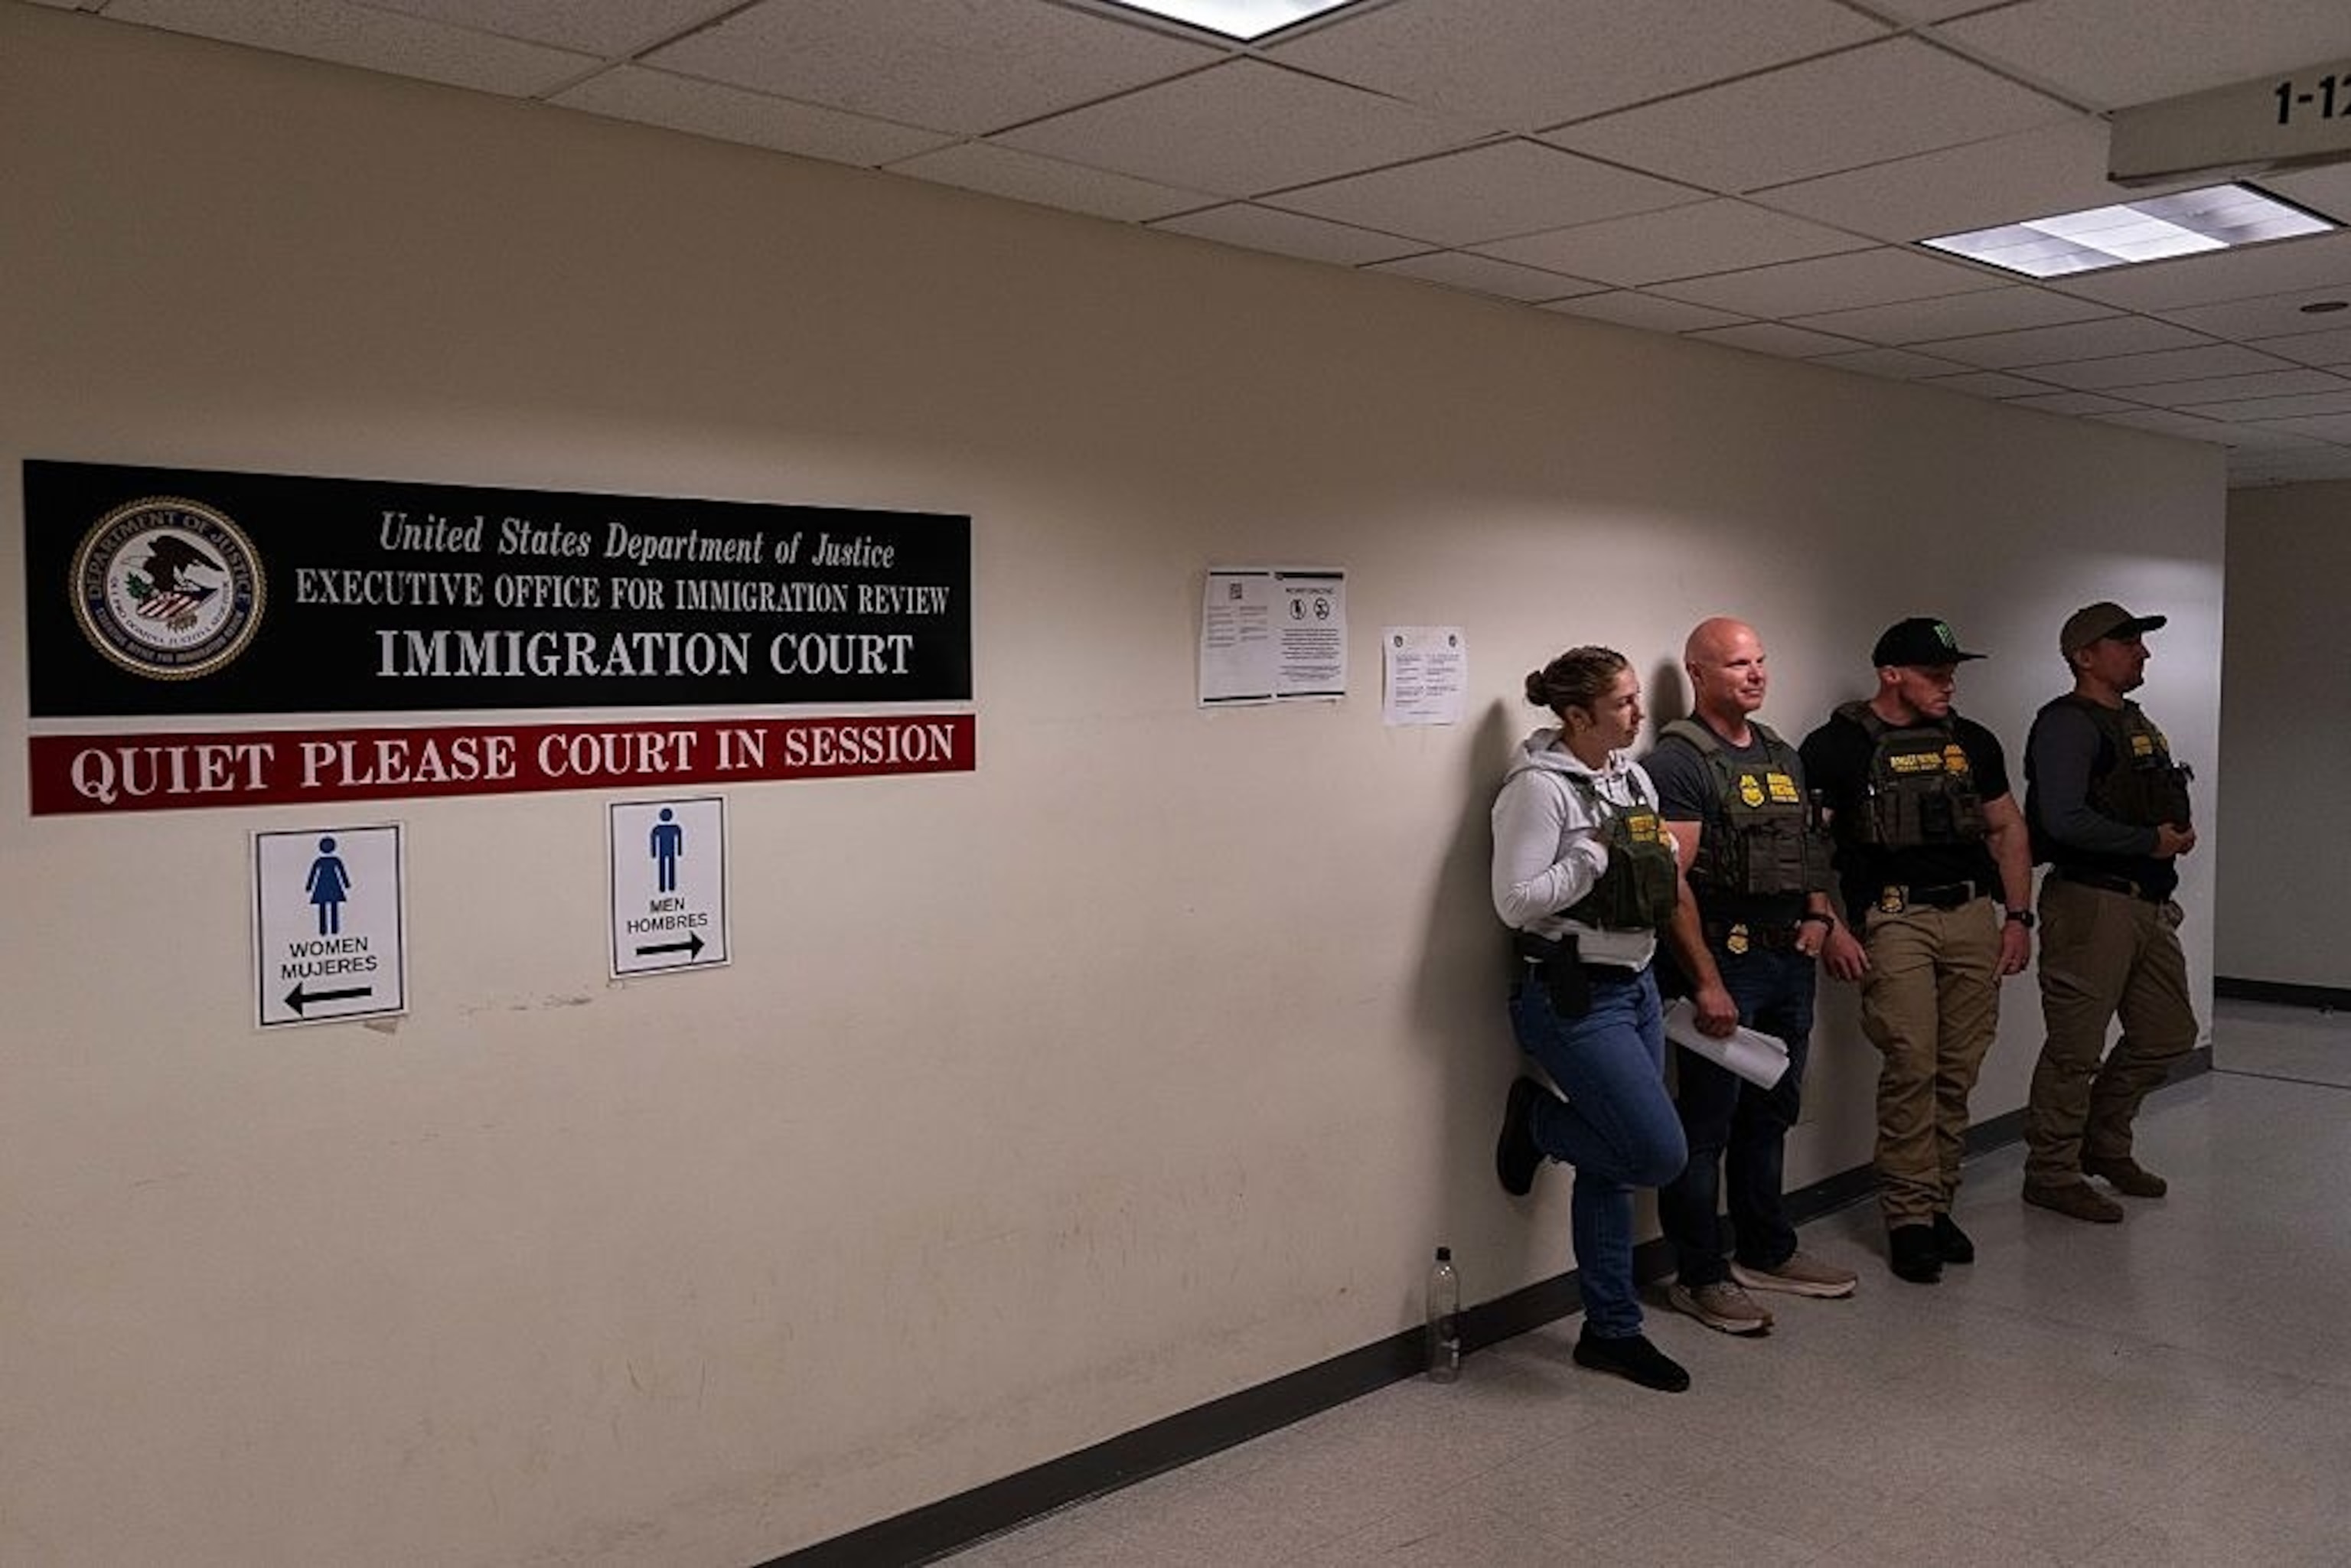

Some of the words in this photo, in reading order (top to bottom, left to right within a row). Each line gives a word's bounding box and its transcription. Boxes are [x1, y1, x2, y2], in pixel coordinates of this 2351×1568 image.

[87, 512, 177, 598] DEPARTMENT
[184, 515, 211, 535] OF
[211, 530, 252, 605] JUSTICE
[380, 511, 483, 553] United
[498, 517, 591, 556] States
[604, 523, 763, 566] Department
[775, 532, 802, 564] of
[812, 533, 894, 568] Justice
[295, 569, 483, 606] EXECUTIVE
[495, 574, 600, 609] OFFICE
[611, 578, 664, 610] FOR
[676, 580, 848, 612] IMMIGRATION
[858, 585, 949, 614] REVIEW
[376, 631, 751, 676] IMMIGRATION
[771, 633, 913, 674] COURT
[71, 744, 273, 804] QUIET
[300, 736, 516, 790] PLEASE
[538, 731, 696, 777] COURT
[716, 729, 767, 771] IN
[785, 724, 954, 767] SESSION
[627, 913, 707, 934] HOMBRES
[650, 898, 685, 912] MEN
[282, 956, 377, 980] MUJERES
[289, 937, 368, 957] WOMEN
